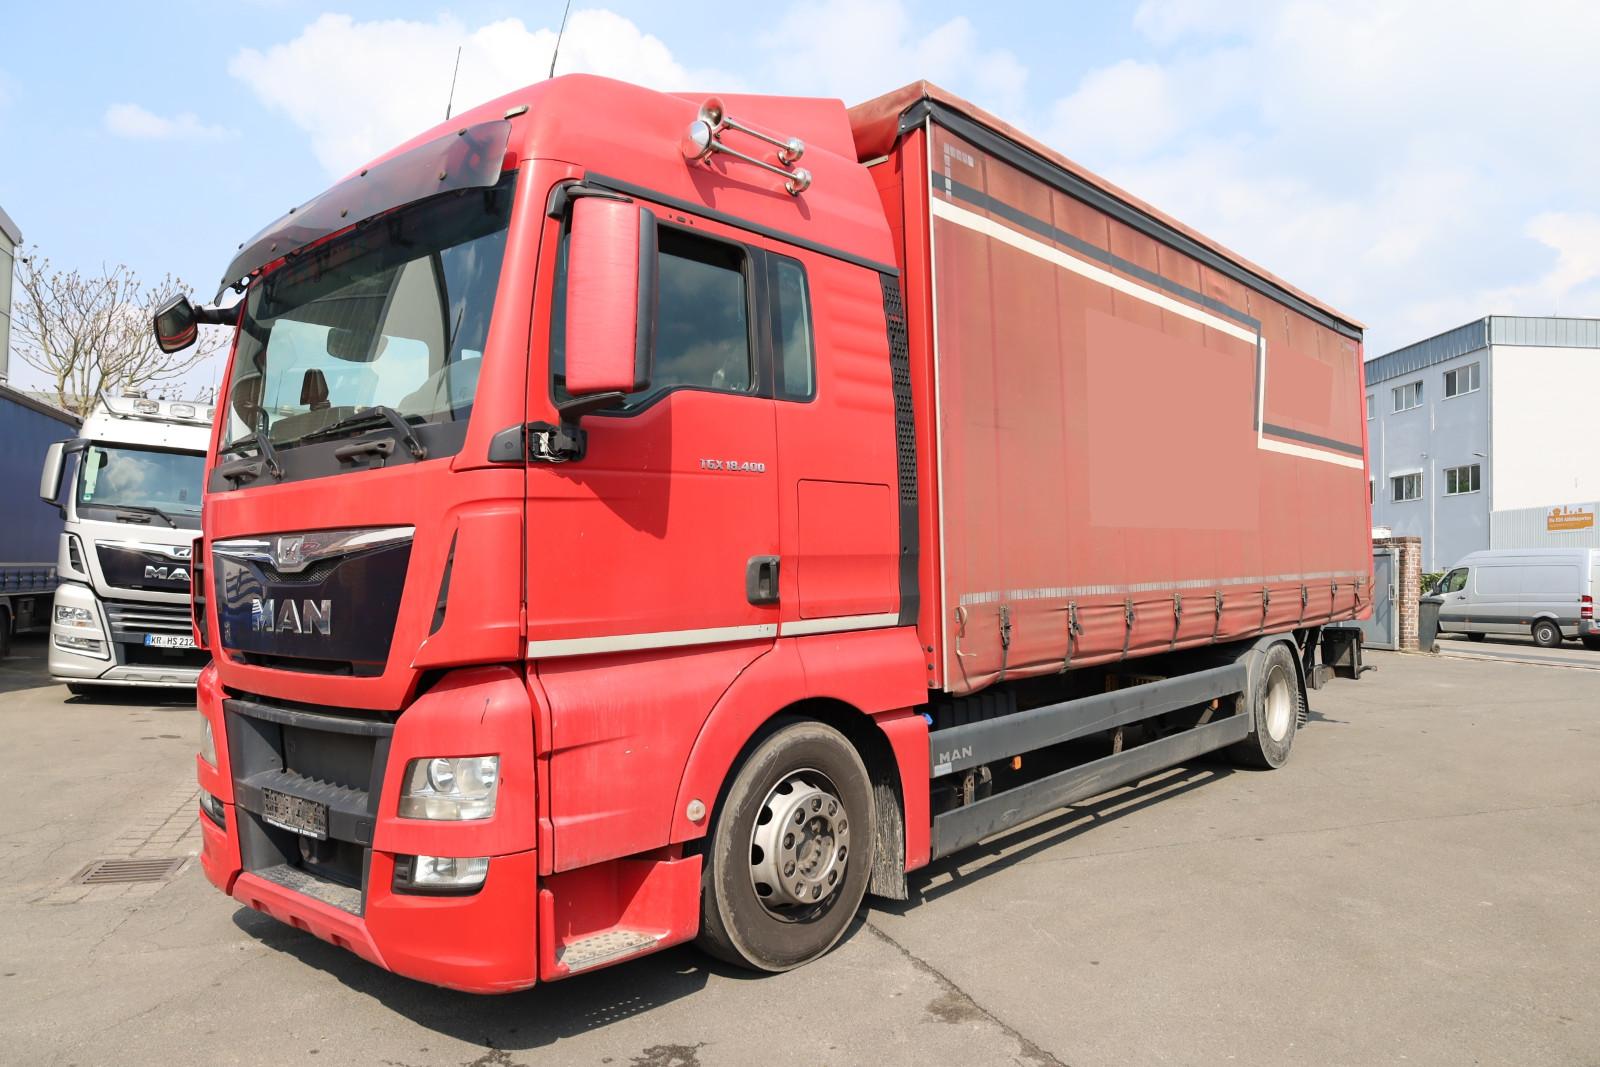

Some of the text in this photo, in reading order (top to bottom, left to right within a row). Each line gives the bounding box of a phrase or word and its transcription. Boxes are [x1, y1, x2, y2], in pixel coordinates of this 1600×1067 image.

[700, 459, 766, 473] TGX 18.400
[144, 566, 191, 581] MA
[251, 599, 332, 635] MAN
[151, 636, 162, 644] KR
[167, 637, 177, 645] HS
[939, 745, 973, 763] MAN
